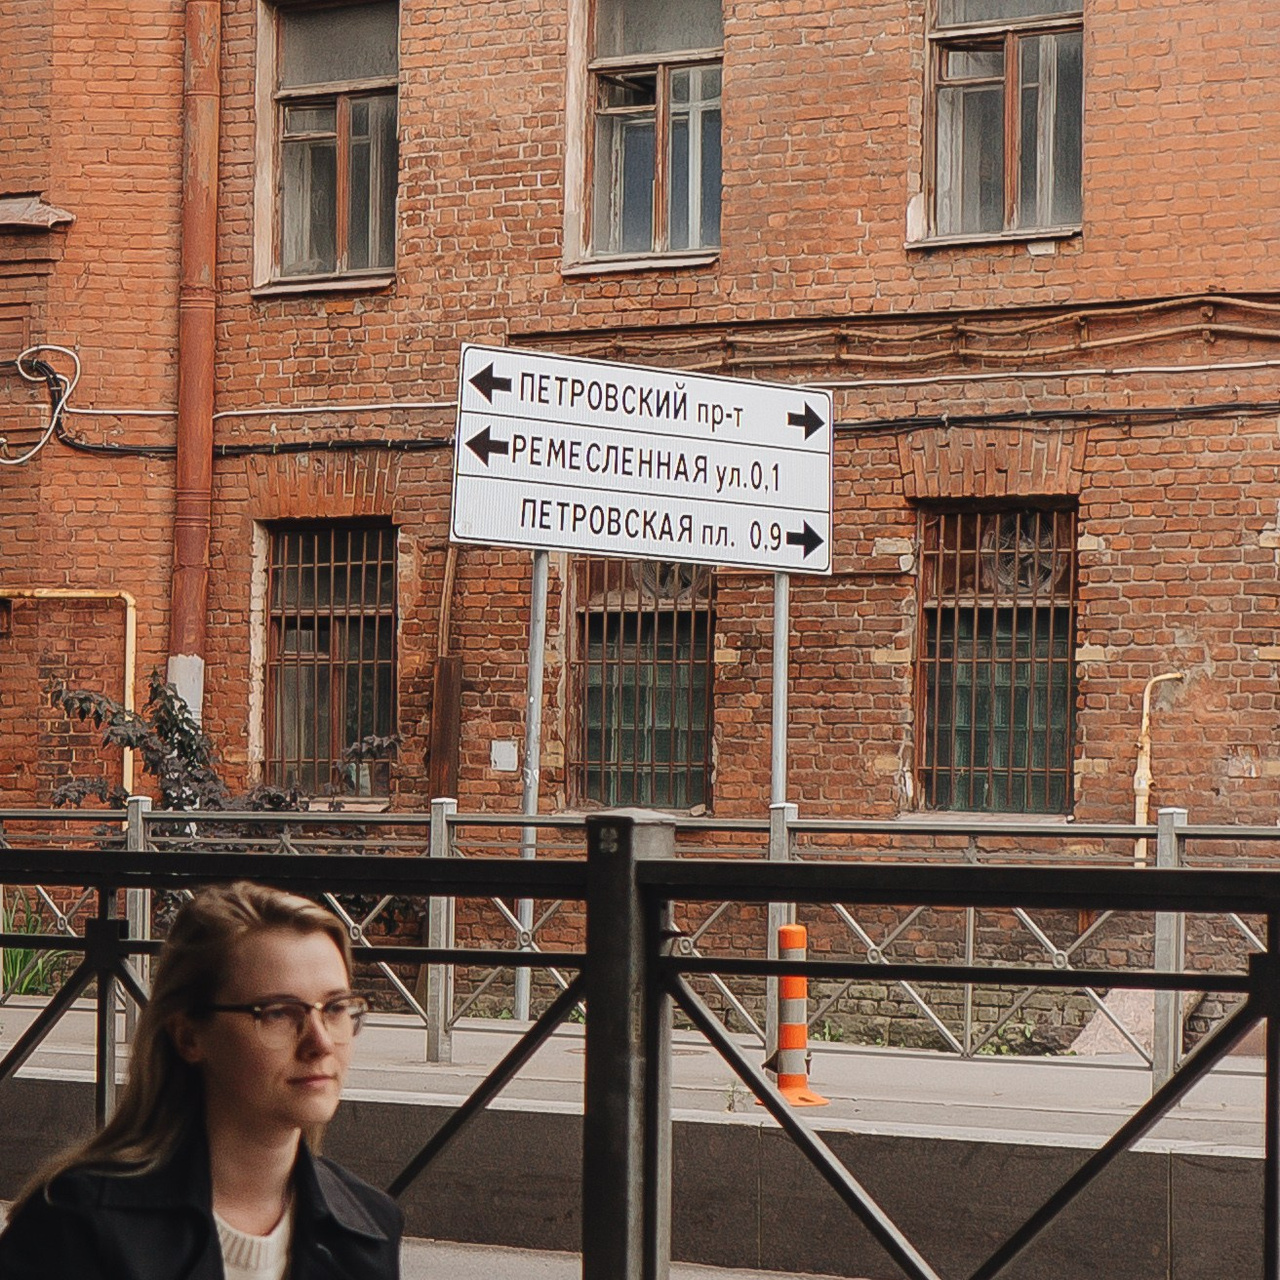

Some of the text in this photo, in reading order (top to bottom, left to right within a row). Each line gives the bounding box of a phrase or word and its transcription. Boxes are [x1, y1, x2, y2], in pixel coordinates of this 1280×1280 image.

[520, 371, 744, 433] ПЕТРОВСКИЙ пр-т
[512, 434, 708, 484] РЕМЕСЛЕННАЯ
[521, 498, 781, 553] ПЕТРОВСКАЯ пл. 0,9
